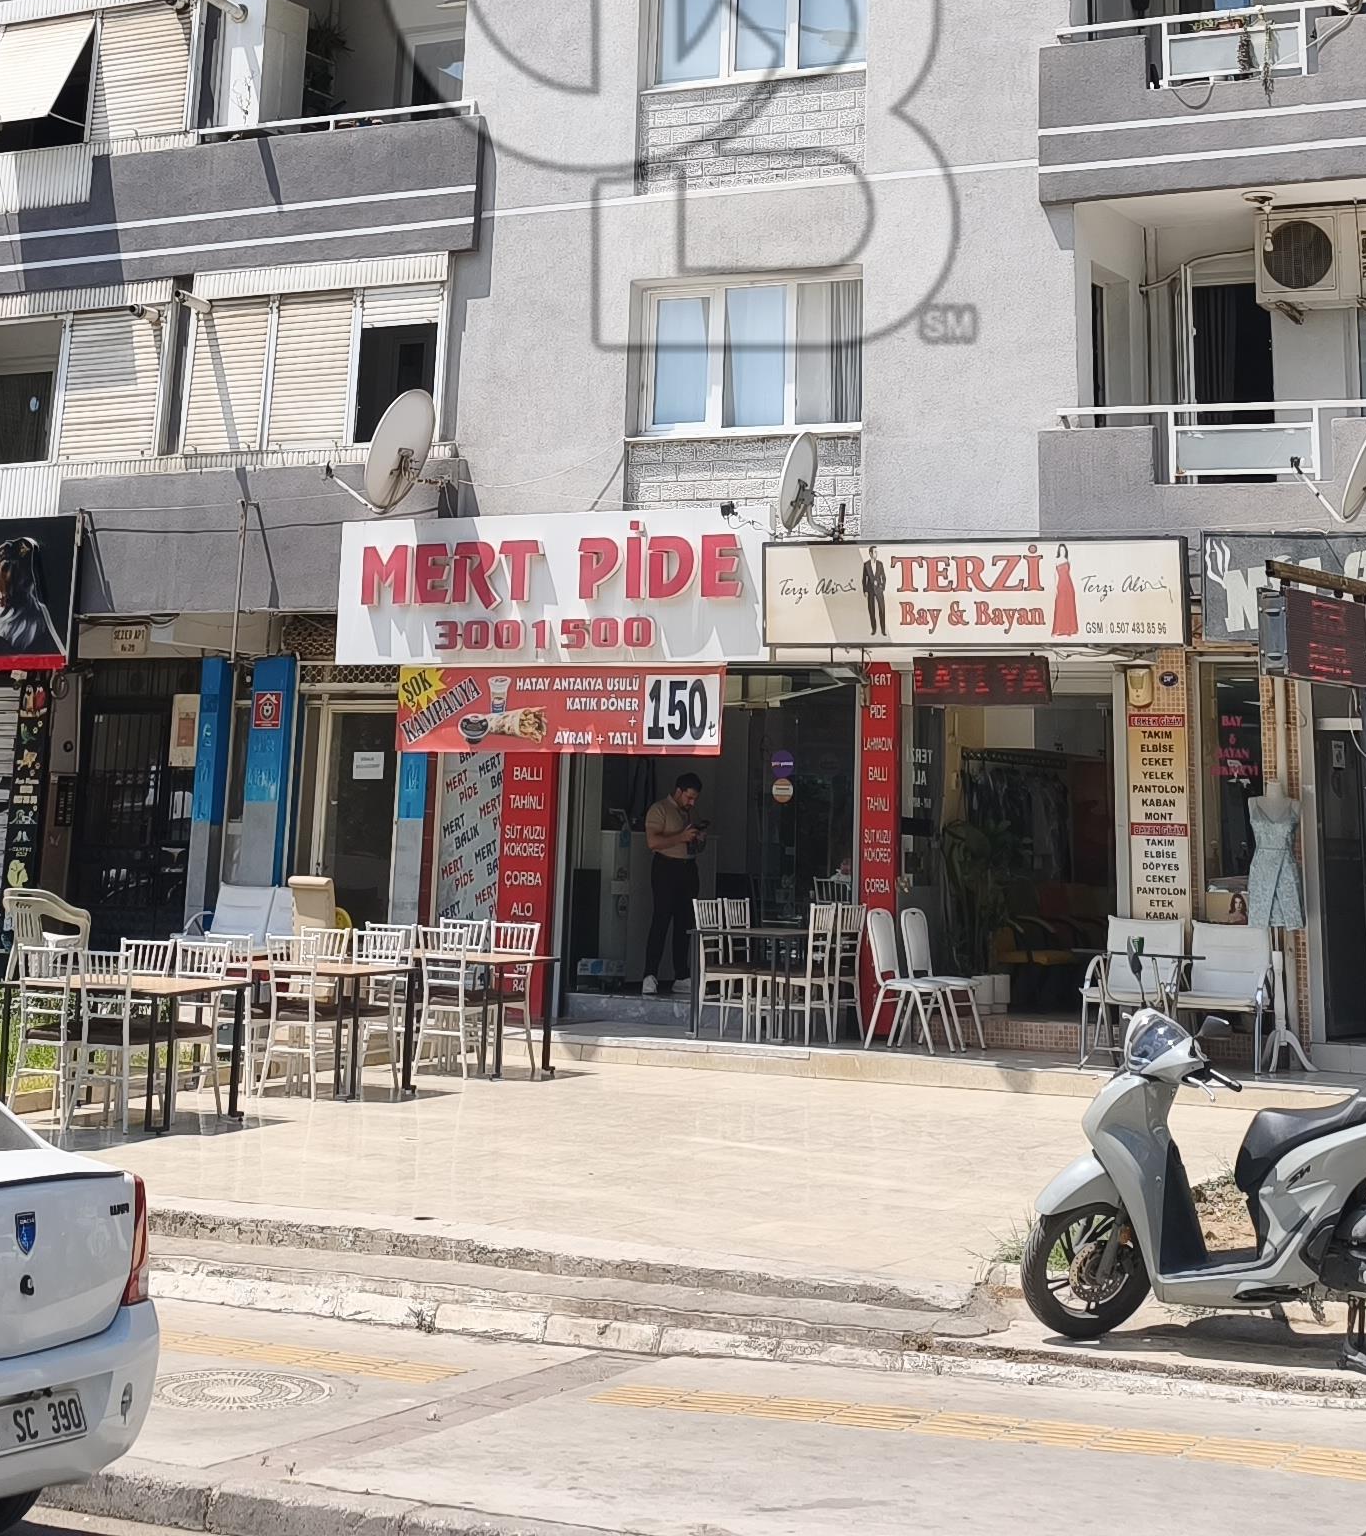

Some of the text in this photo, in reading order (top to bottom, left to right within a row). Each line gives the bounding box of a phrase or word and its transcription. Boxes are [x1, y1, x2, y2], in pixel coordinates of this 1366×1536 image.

[360, 520, 743, 610] MERT PİDE
[891, 544, 1046, 593] TERZİ
[899, 601, 1047, 635] Bay & Bayan
[1085, 622, 1103, 634] GSM
[401, 670, 432, 707] ŞOK
[516, 674, 640, 692] HATAY ANTAKYA USULÜ
[400, 677, 482, 744] KAMPANYA
[566, 695, 639, 711] KATIK DÖNER
[869, 701, 887, 719] PİDE
[554, 731, 592, 745] AYRAN
[608, 732, 636, 746] TATLI
[1141, 730, 1172, 739] TAKIM
[1140, 743, 1175, 753] ELBİSE
[479, 753, 501, 778] MERT
[1141, 757, 1174, 767] CEKET
[445, 769, 468, 794] MERT
[513, 767, 543, 781] BALLI
[868, 766, 888, 781] BALLI
[1142, 771, 1174, 780] YELEK
[458, 782, 479, 805] PİDE
[1132, 784, 1185, 794] PANTOLON
[479, 794, 501, 819] MERT
[509, 792, 544, 810] TAHİNLİ
[1141, 798, 1176, 807] KABAN
[1144, 812, 1173, 821] MONT
[443, 813, 465, 839] MERT
[523, 825, 546, 840] KUZU
[454, 823, 480, 850] BALIK
[1145, 838, 1175, 847] TAKIM
[475, 839, 497, 864] MERT
[503, 842, 546, 861] KOKOREÇ
[1144, 849, 1177, 859] ELBİSE
[441, 855, 464, 880] MERT
[1142, 860, 1180, 872] DÖPYES
[504, 871, 542, 888] ÇORBA
[1145, 875, 1176, 883] CEKET
[1136, 886, 1187, 896] PANTOLON
[511, 902, 533, 916] ALO
[1149, 899, 1174, 908] ETEK
[13, 1407, 39, 1442] SC
[47, 1398, 82, 1434] 390
